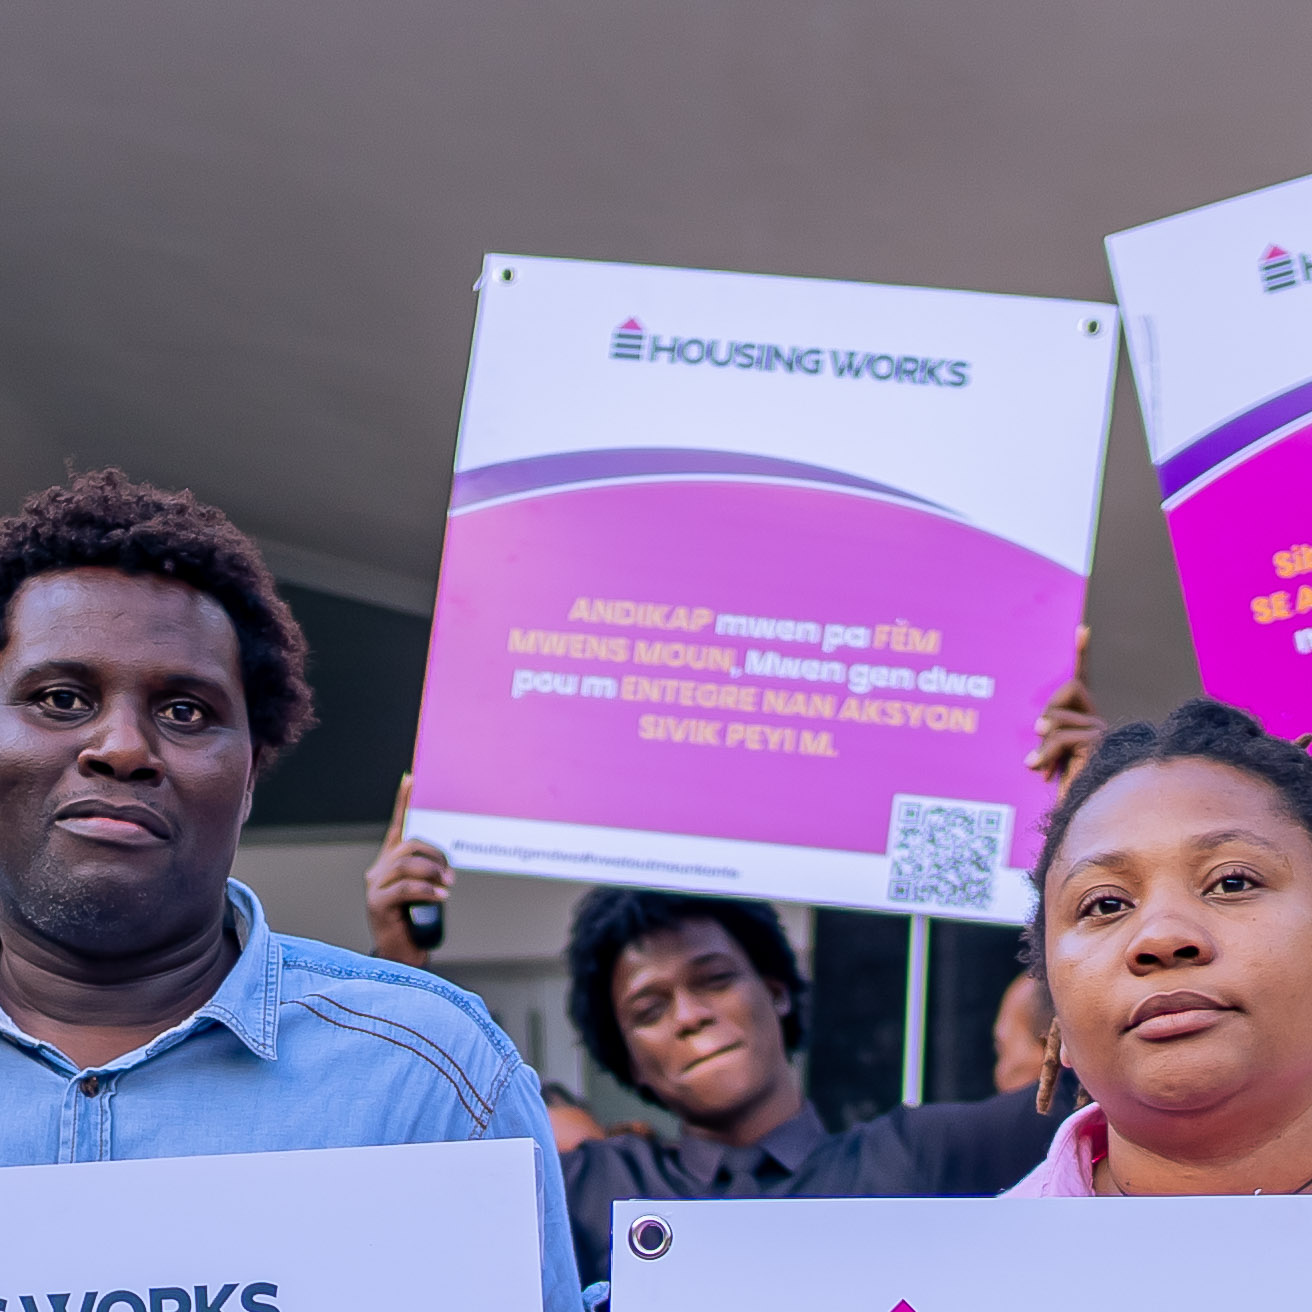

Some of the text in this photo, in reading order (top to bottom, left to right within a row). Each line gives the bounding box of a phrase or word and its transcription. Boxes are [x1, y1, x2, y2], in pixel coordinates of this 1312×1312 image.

[649, 335, 972, 388] HOUSING WORKS
[568, 598, 942, 654] ANDIKAP mwen pa FÈM
[1251, 592, 1295, 624] SE
[508, 628, 629, 662] MWENS
[744, 650, 846, 683] Mwen
[847, 661, 915, 693] gen
[917, 667, 994, 698] dwa
[511, 669, 978, 733] pou m ENTEGRE NAN AKSYON
[639, 714, 721, 745] SIVIK
[725, 723, 795, 752] PEYI
